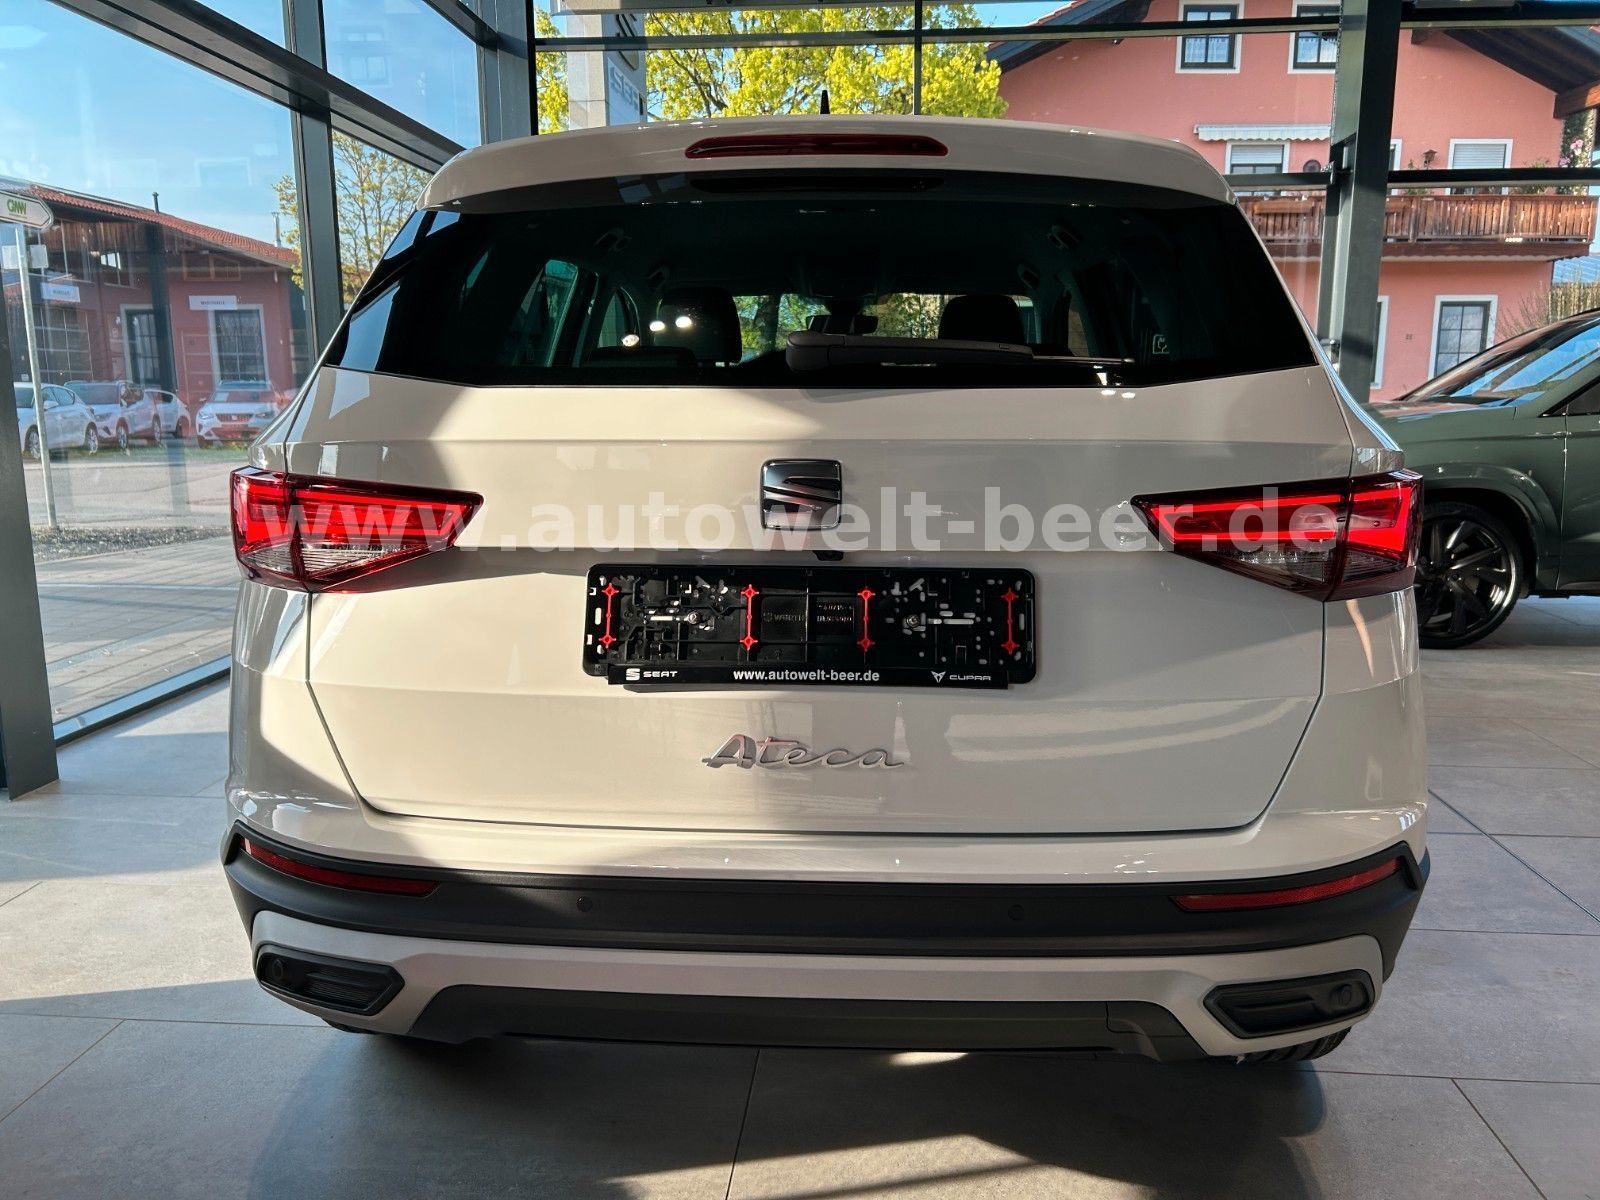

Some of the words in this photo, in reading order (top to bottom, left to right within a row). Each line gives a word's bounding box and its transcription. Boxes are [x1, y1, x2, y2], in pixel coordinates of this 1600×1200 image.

[642, 670, 678, 678] SEAT
[733, 669, 880, 682] www.autowelt-beer.de
[702, 734, 905, 769] Ateca
